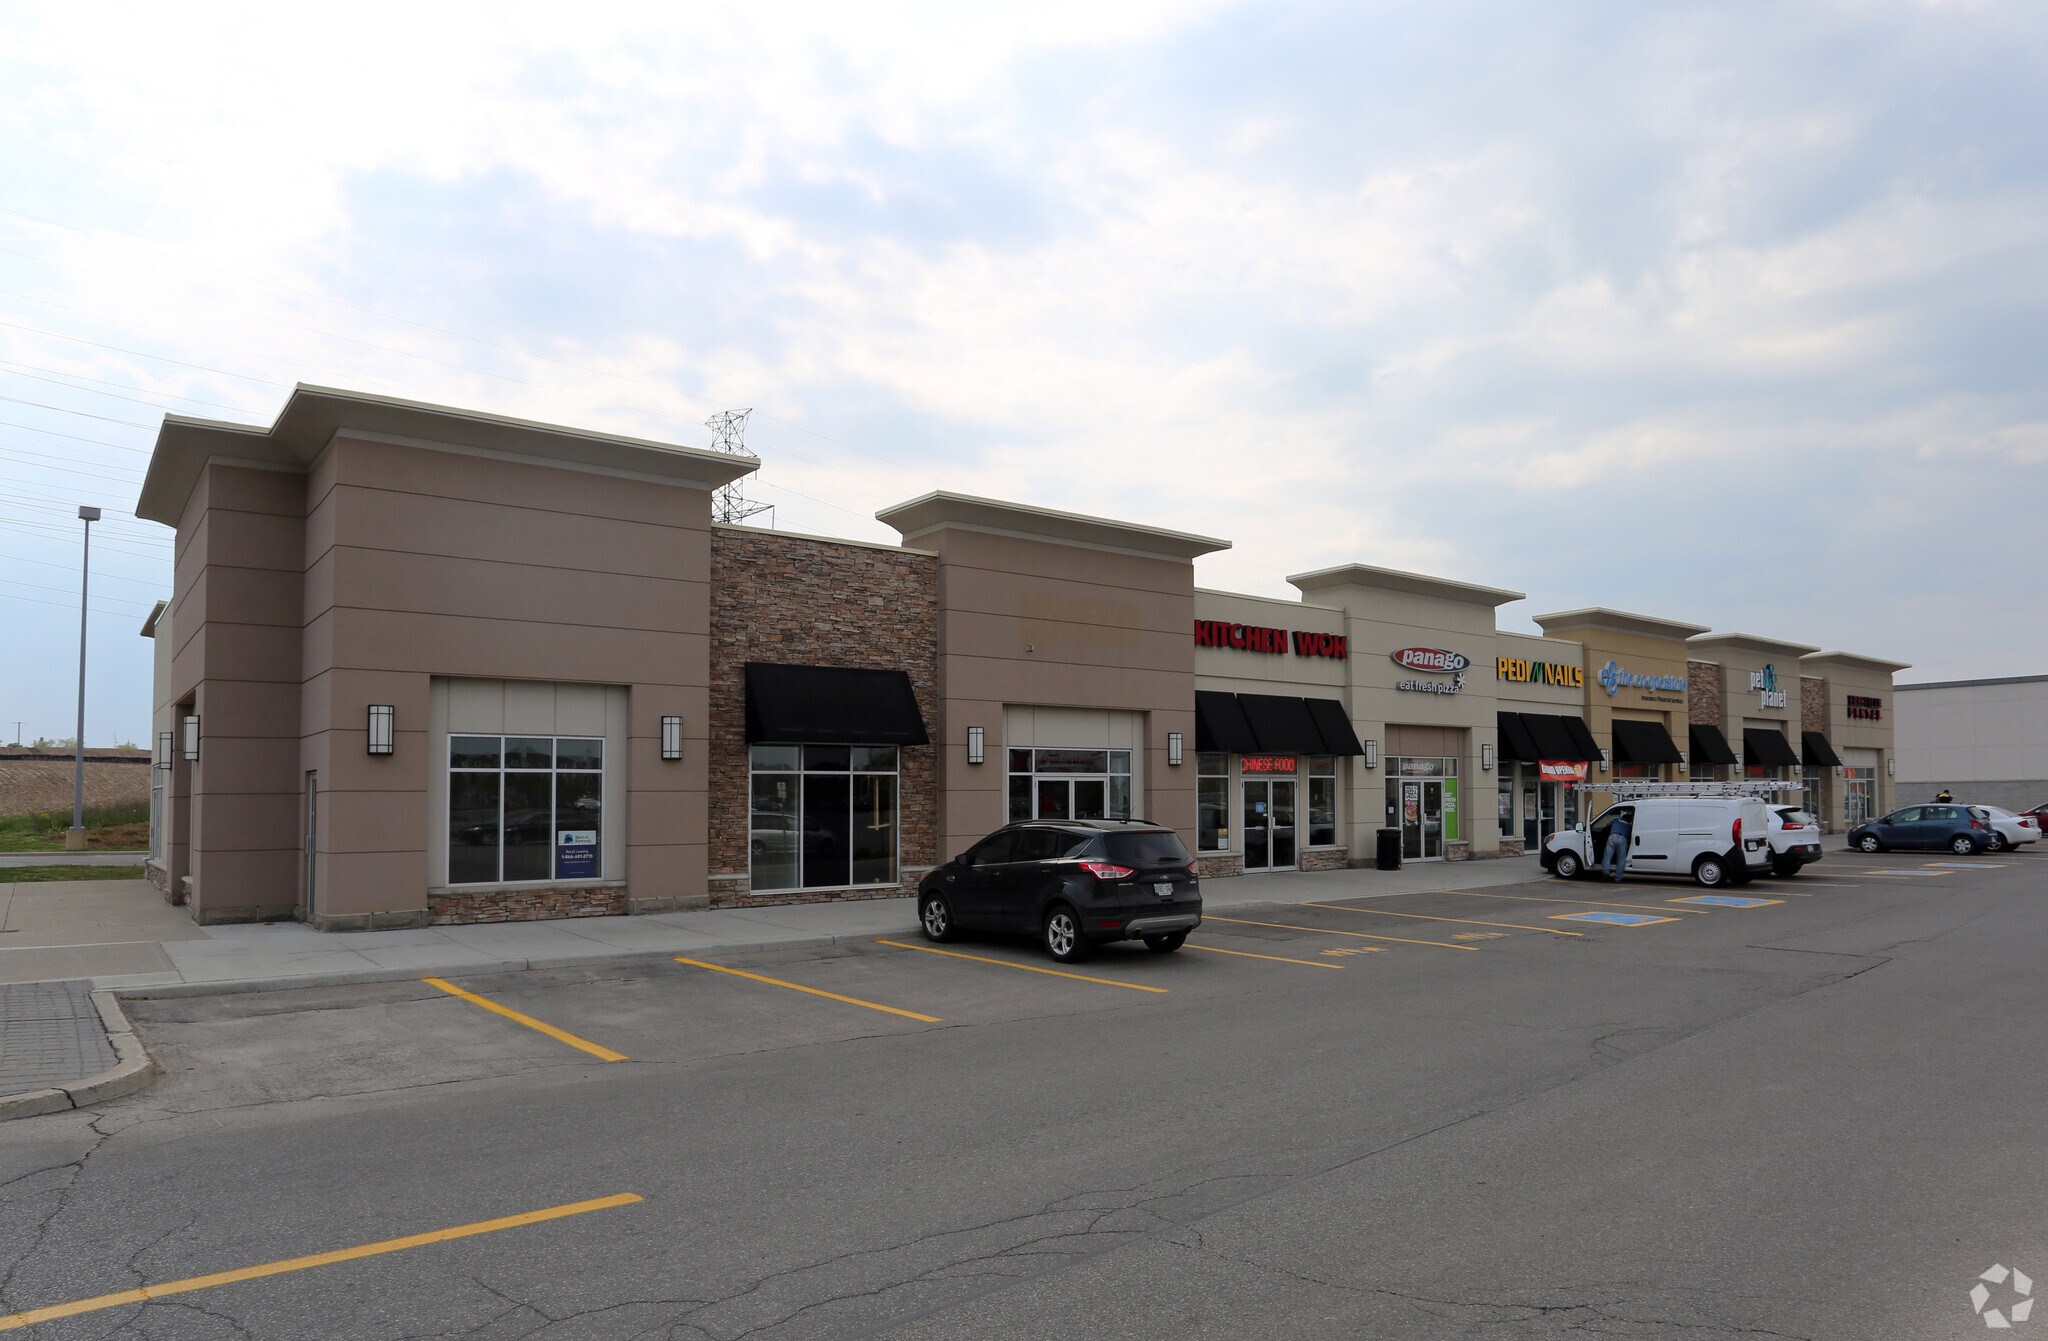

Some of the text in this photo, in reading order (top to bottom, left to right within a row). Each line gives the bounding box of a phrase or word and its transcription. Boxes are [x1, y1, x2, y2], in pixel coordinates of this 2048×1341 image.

[1194, 619, 1348, 659] KITCHEN WOK
[1402, 649, 1465, 670] panago
[1496, 657, 1531, 682] PEDI
[1545, 662, 1584, 688] NAILS
[1618, 667, 1635, 686] the
[1750, 669, 1765, 691] pet
[1399, 680, 1460, 695] eat fresh pizza
[1761, 687, 1787, 710] planet
[1241, 758, 1295, 771] CHINESE FOOD
[1402, 761, 1434, 771] panago
